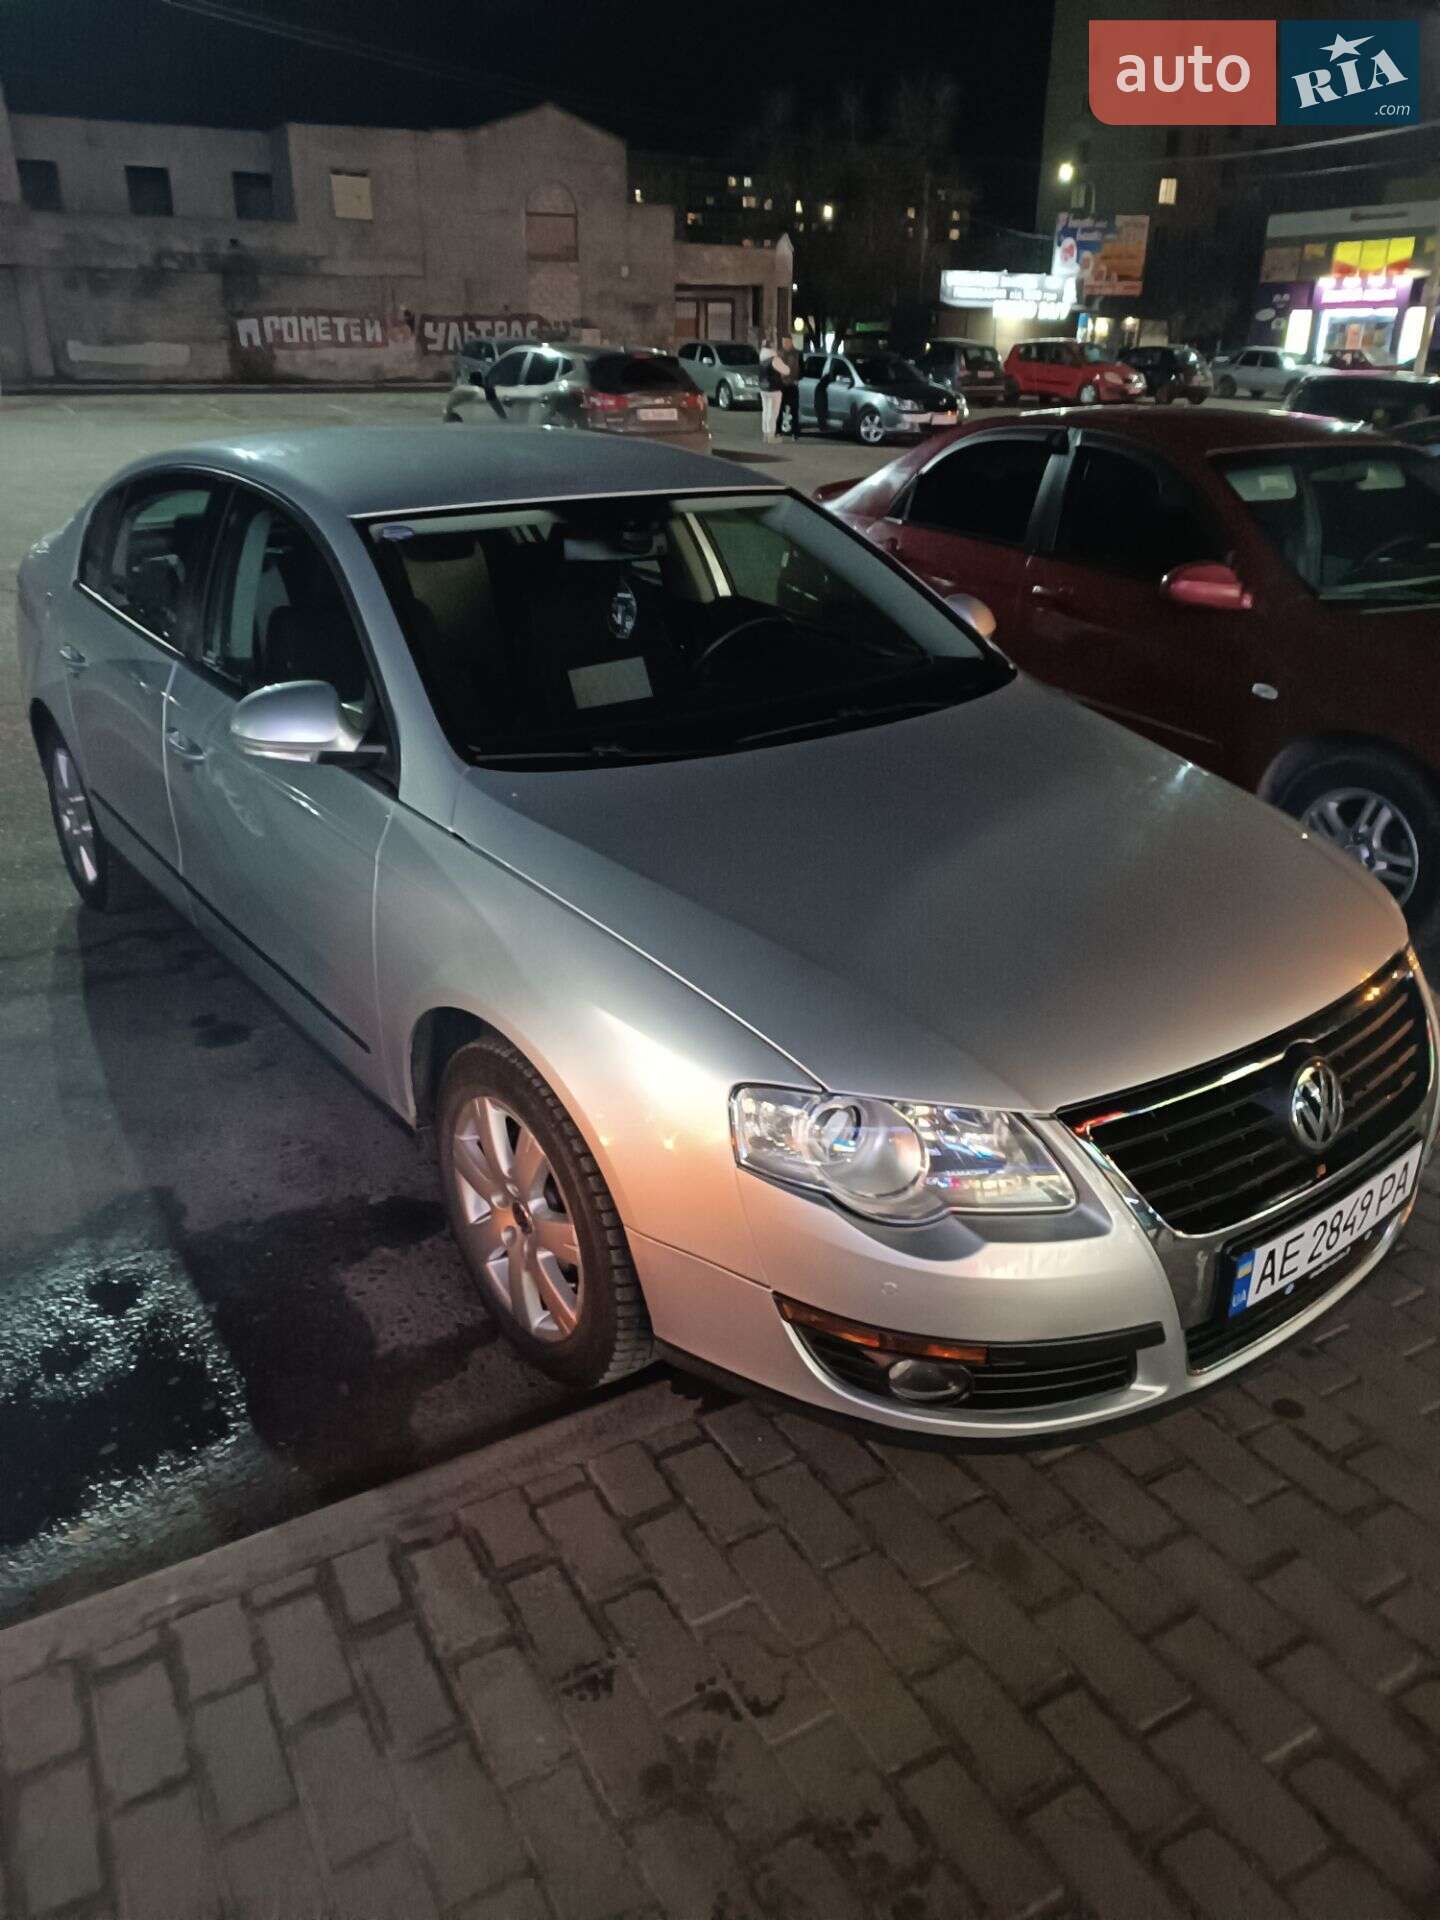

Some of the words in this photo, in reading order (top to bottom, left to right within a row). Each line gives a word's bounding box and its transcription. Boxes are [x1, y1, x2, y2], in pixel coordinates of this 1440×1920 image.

[1256, 1232, 1305, 1294] AE
[1308, 1189, 1374, 1264] 2849
[1376, 1163, 1410, 1214] PA
